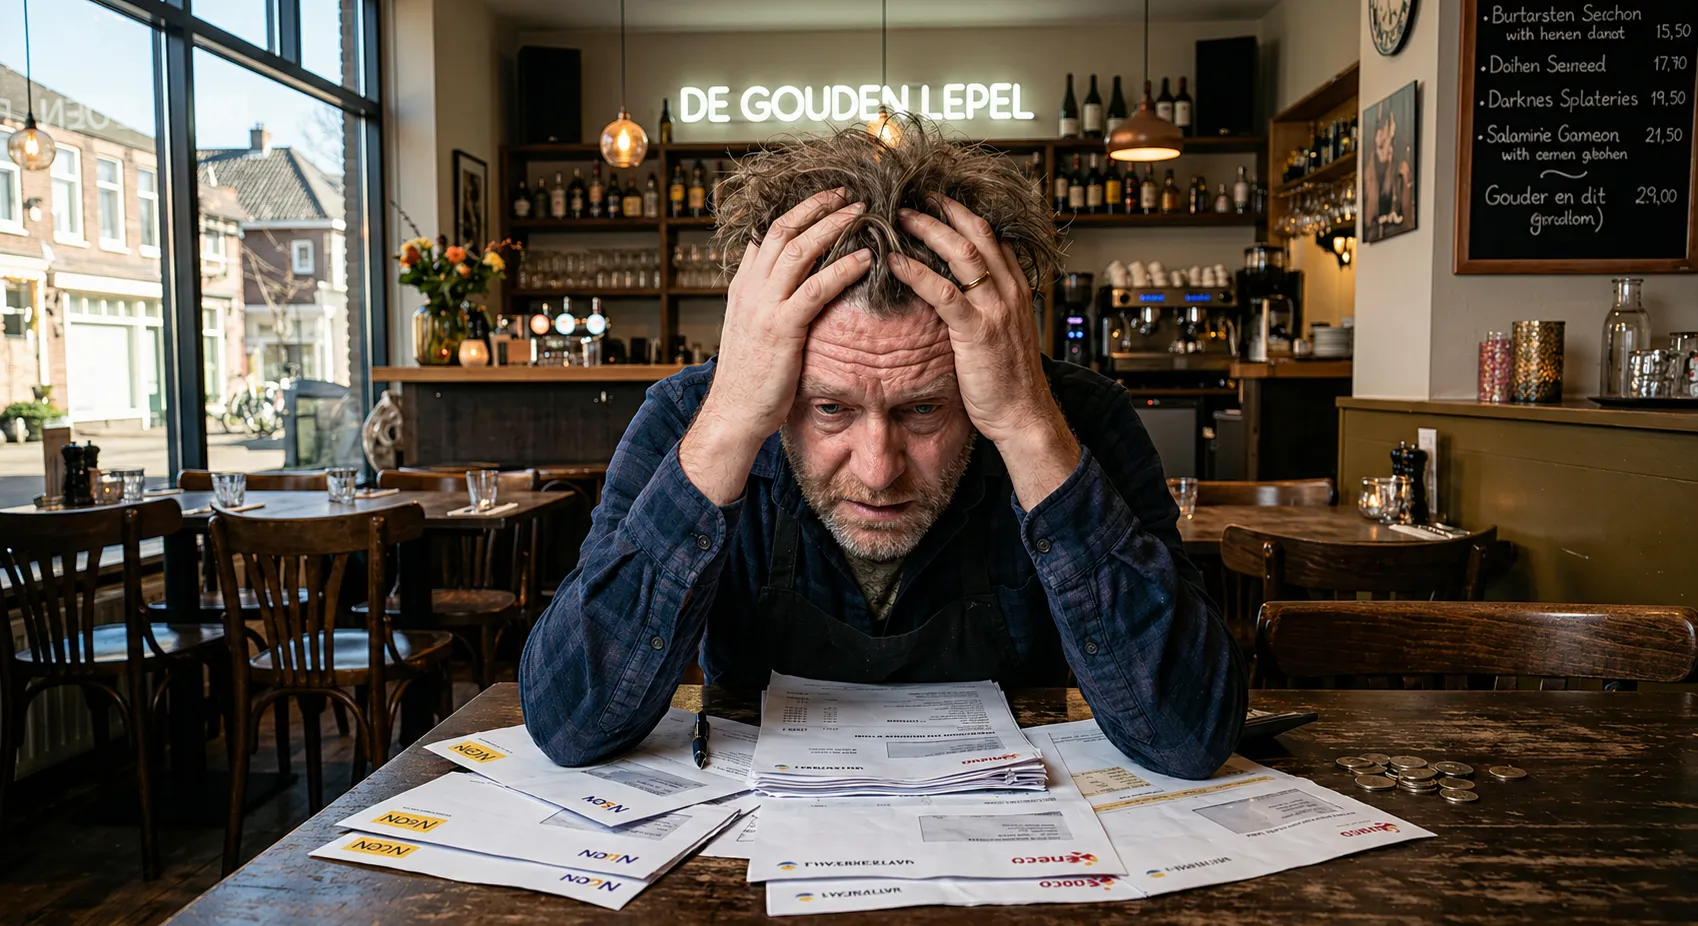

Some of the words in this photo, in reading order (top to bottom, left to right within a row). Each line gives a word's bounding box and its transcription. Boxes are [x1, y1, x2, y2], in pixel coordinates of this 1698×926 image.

[1492, 4, 1575, 24] Burtarsten
[1506, 26, 1535, 41] with
[1656, 23, 1692, 41] 15,50
[1490, 54, 1540, 74] Doihen
[680, 86, 731, 123] DE
[740, 84, 911, 123] GOUDEN
[921, 83, 1035, 120] LEPEL
[1488, 89, 1554, 109] Darknes
[1559, 88, 1639, 113] Splateries
[1651, 90, 1686, 107] 19,50
[1557, 123, 1620, 143] Gameon
[1645, 126, 1683, 145] 21,50
[1501, 147, 1530, 161] with
[1485, 184, 1549, 206] Gouder
[1554, 191, 1575, 205] en
[1580, 186, 1606, 205] dit
